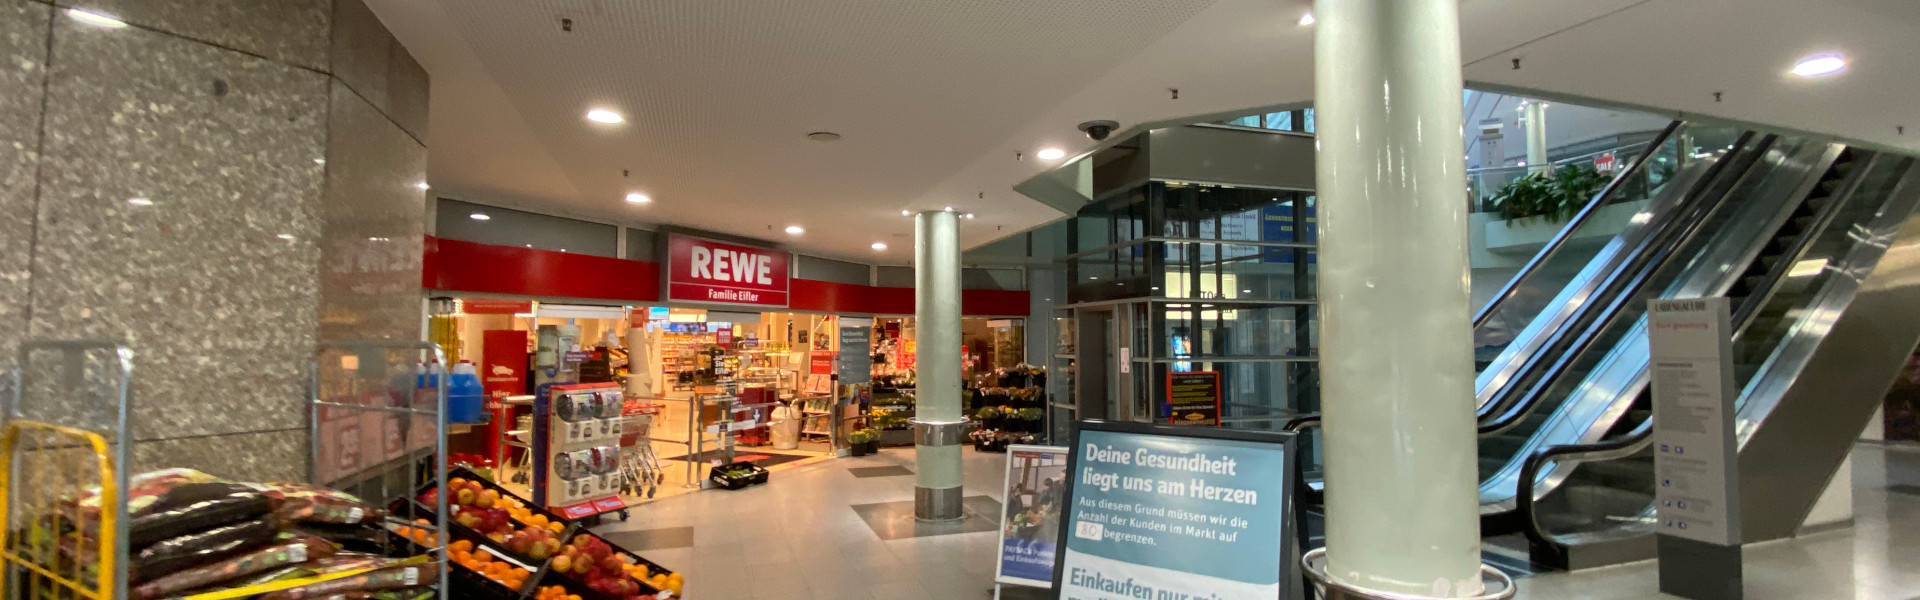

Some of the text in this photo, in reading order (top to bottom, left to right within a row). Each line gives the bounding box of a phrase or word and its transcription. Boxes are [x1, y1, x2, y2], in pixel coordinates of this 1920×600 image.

[691, 245, 772, 285] REWE
[708, 288, 759, 301] Familie Eifler
[1085, 443, 1237, 476] Deine Gesundheit
[1082, 467, 1257, 506] liegt uns am Herzen
[1077, 510, 1238, 543] Anzahl der Kunden im Markt auf
[1079, 496, 1248, 529] Aus diesem Grund müssen wir die
[1104, 527, 1157, 546] begrenzen.
[1070, 566, 1153, 600] Einkaufen
